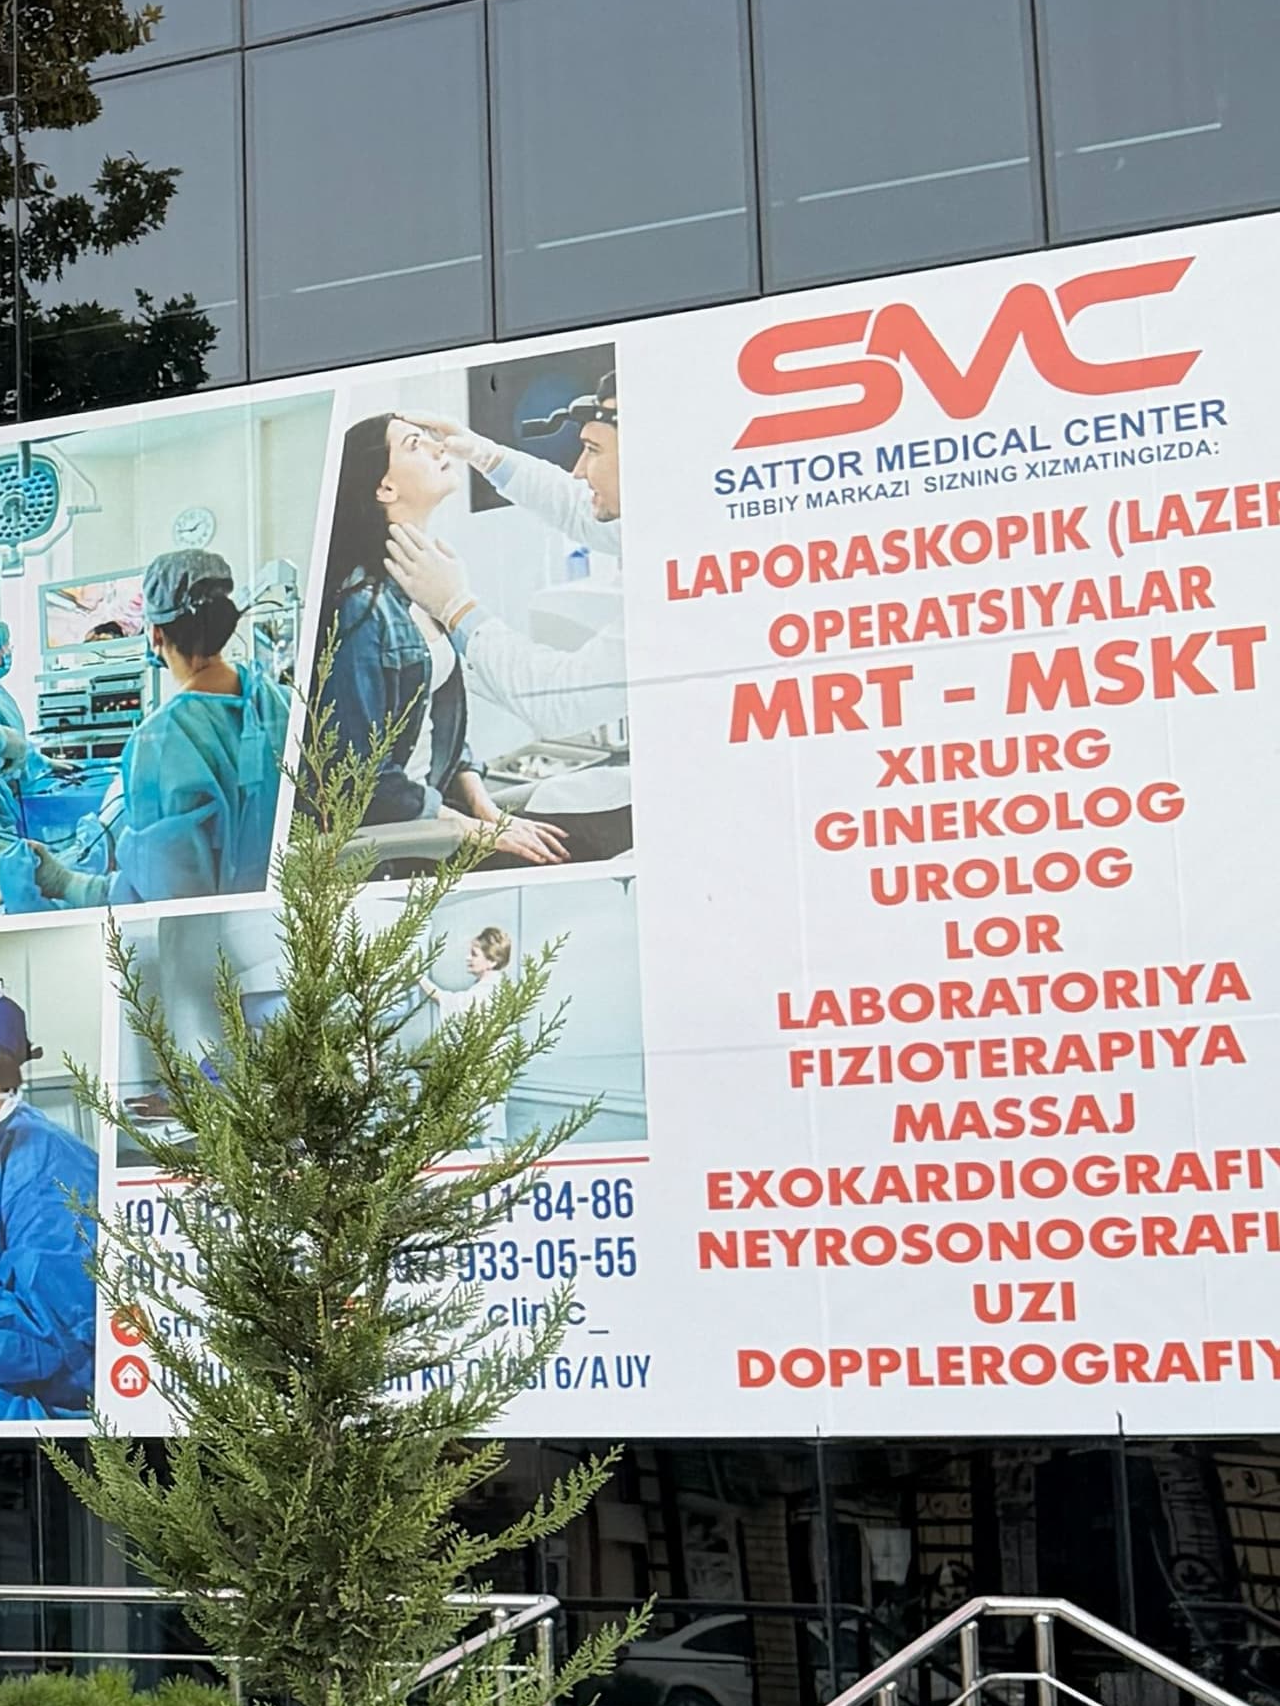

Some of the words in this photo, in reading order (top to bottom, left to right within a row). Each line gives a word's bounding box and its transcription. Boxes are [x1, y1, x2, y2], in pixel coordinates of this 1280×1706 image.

[733, 256, 1203, 449] SMC
[714, 450, 863, 496] SATTOR
[876, 425, 1052, 473] MEDICAL
[1064, 399, 1228, 446] CENTER
[726, 495, 799, 520] TIBBIY
[806, 480, 910, 510] MARKAZI
[924, 466, 1018, 493] SIZNING
[1025, 439, 1220, 481] XIZMATINGIZDA:
[666, 508, 1089, 600] LAPORASKOPIK
[768, 566, 1214, 658] OPERATSIYALAR
[729, 666, 913, 743] MRT
[1006, 626, 1267, 714] MSKT
[878, 728, 1110, 787] XIRURG
[815, 782, 1185, 851] GINEKOLOG
[871, 848, 1132, 906] UROLOG
[945, 914, 1063, 960] LOR
[777, 962, 1251, 1030] LABORATORIYA
[789, 1024, 1246, 1088] FIZIOTERAPIYA
[893, 1092, 1135, 1143] MASSAJ
[462, 1178, 634, 1223] 11-84-86
[457, 1237, 637, 1283] 933-05-55
[698, 1211, 1280, 1270] NEYROSONOGRAFI
[973, 1281, 1077, 1324] UZI
[555, 1356, 608, 1389] 6/A
[616, 1354, 651, 1388] UY
